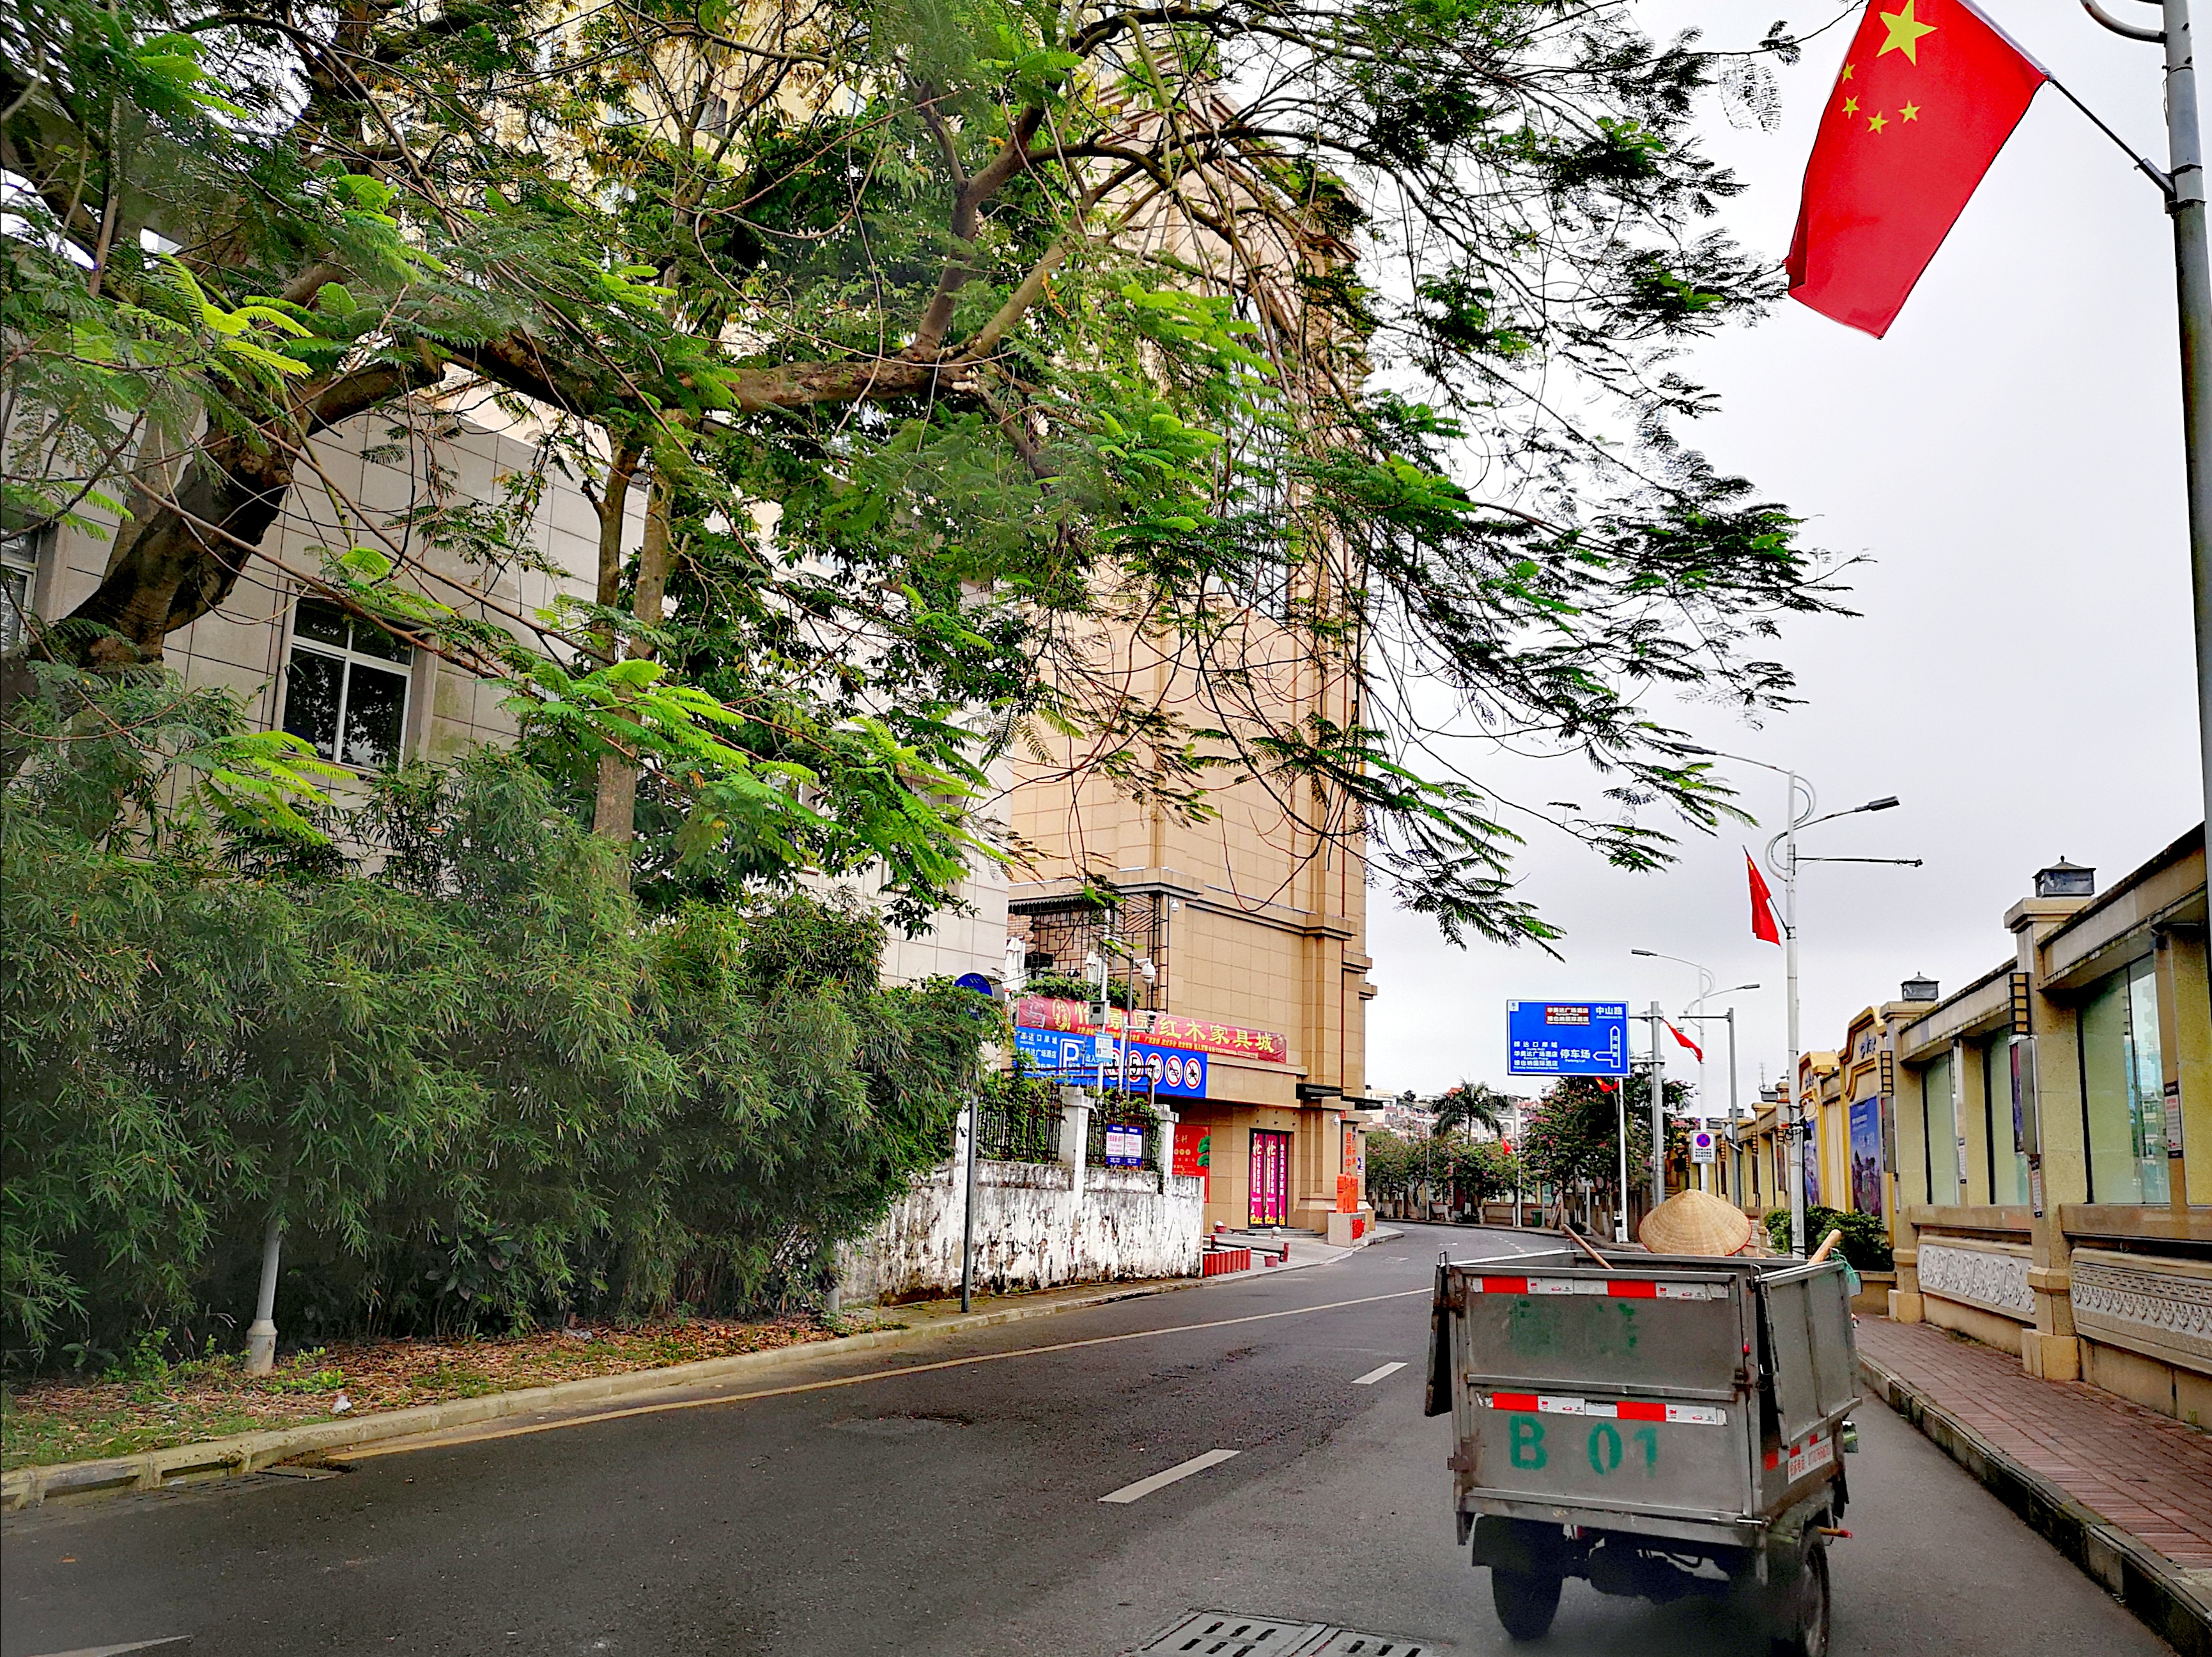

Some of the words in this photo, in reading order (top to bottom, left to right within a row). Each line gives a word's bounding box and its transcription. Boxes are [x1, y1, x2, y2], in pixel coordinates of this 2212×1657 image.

[1596, 1006, 1623, 1015] 中山路
[1085, 1054, 1099, 1063] 出入
[1560, 1049, 1591, 1059] 停车场
[1509, 1415, 1548, 1470] B
[1588, 1422, 1657, 1477] 01
